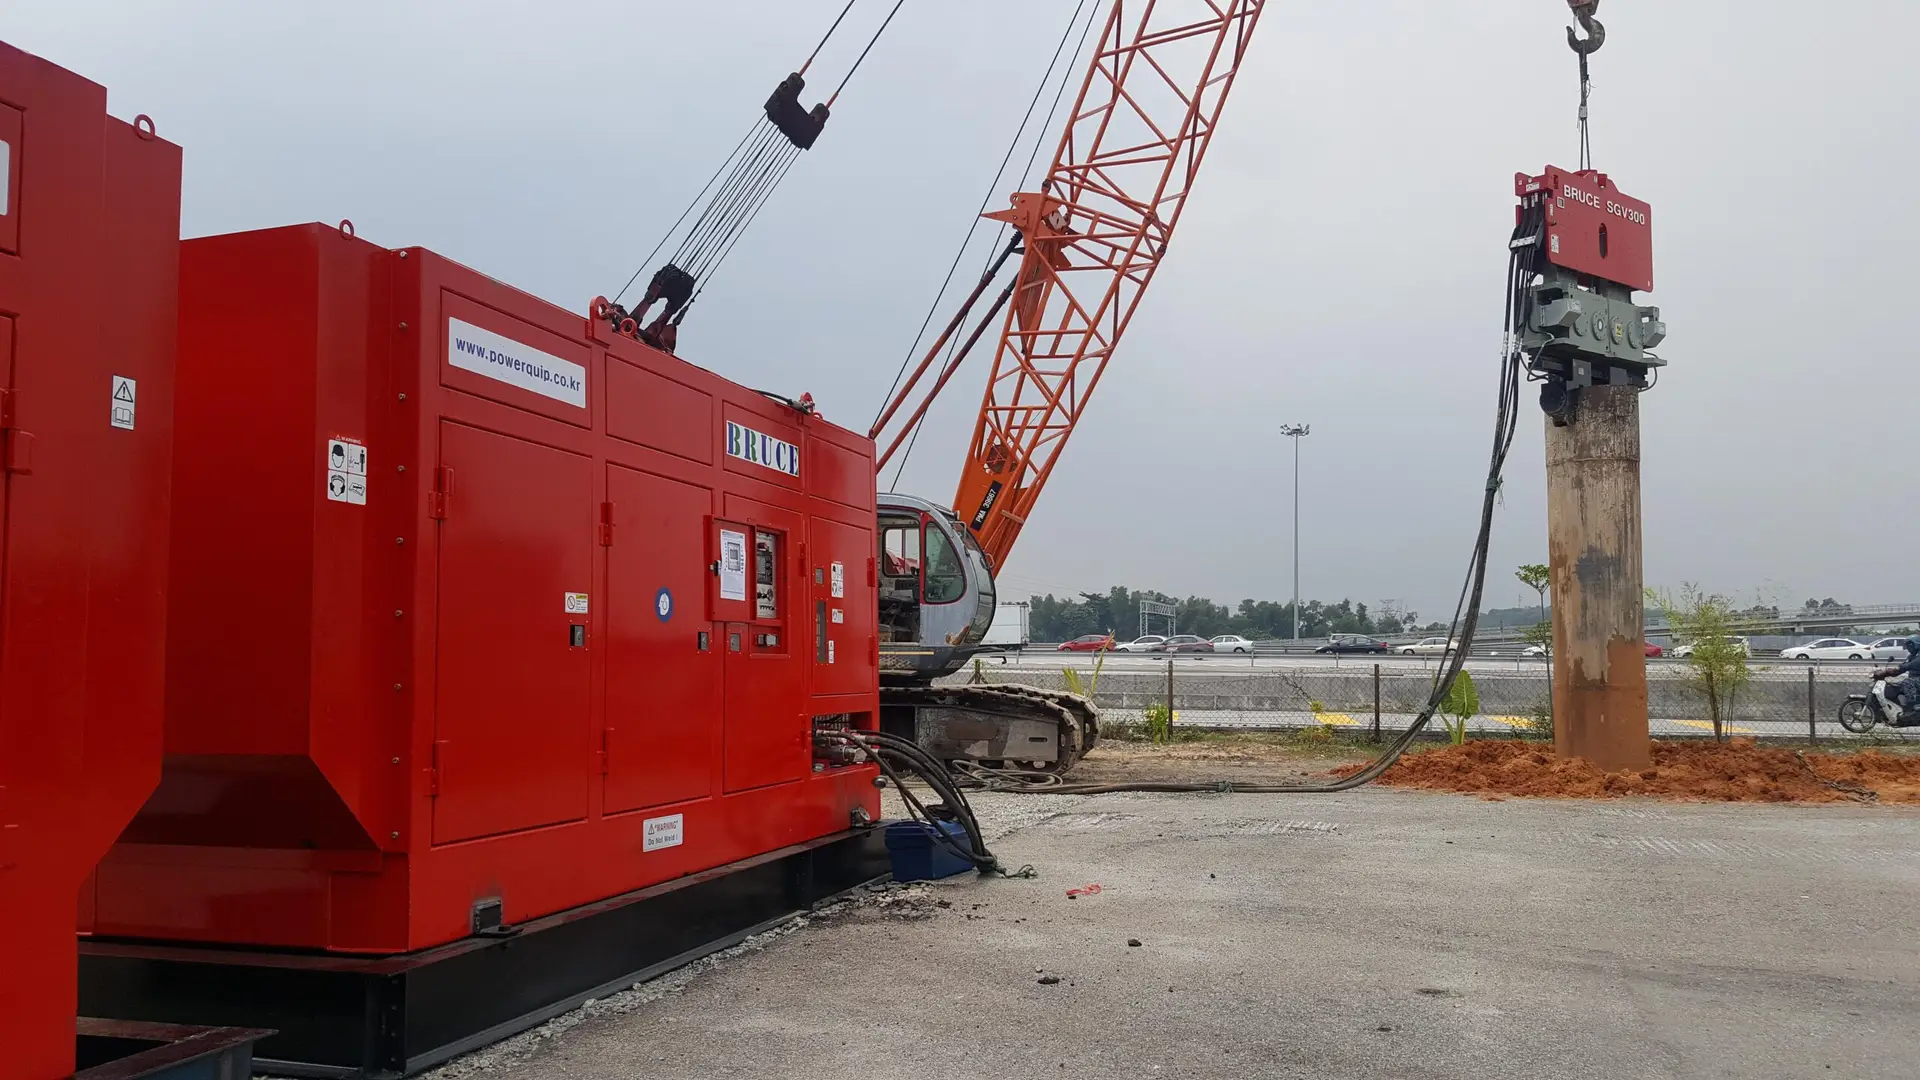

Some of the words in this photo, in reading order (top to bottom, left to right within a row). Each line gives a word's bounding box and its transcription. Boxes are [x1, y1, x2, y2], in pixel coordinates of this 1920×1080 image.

[1563, 184, 1601, 209] BRUCE
[1606, 201, 1645, 225] SGV300
[455, 337, 581, 392] www.powerquip.co.kr
[727, 421, 799, 476] BRUCE
[975, 510, 986, 522] PMA
